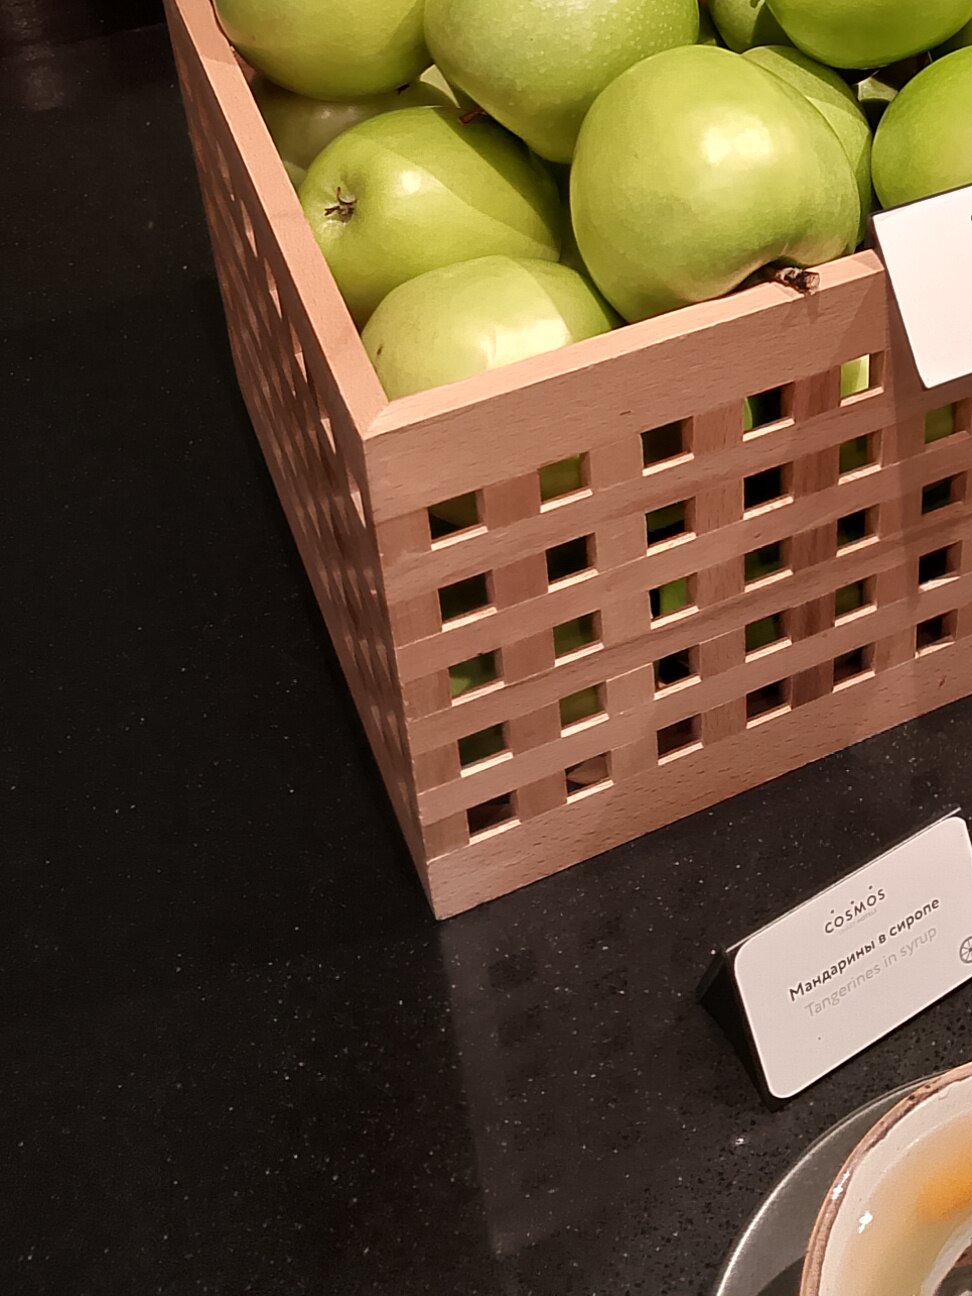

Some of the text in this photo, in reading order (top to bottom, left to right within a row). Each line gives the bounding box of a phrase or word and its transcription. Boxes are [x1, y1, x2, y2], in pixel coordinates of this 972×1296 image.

[789, 941, 875, 1002] Мандарины
[878, 933, 887, 944] в
[889, 898, 940, 937] сиропе
[824, 889, 886, 934] COSMOS
[804, 927, 938, 1017] Tangerines in syrup
